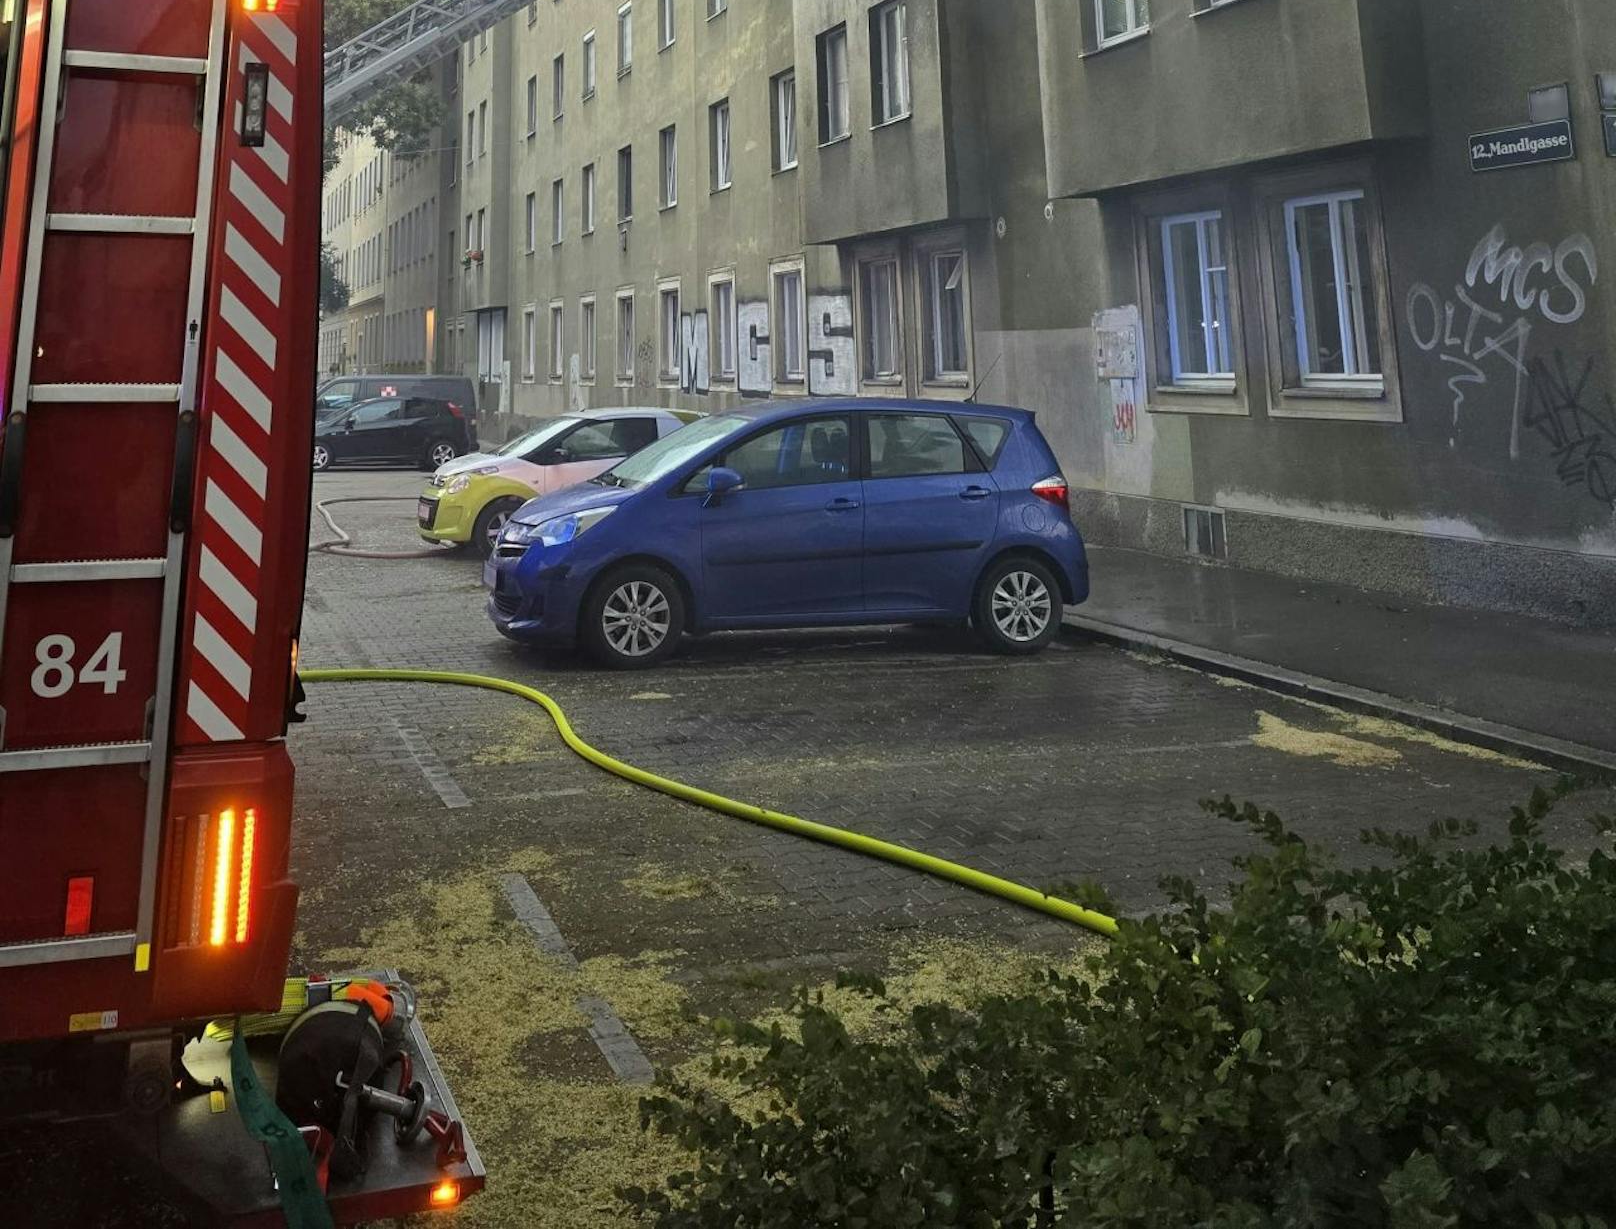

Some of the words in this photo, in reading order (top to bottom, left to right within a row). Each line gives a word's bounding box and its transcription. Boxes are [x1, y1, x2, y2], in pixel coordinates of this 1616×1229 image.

[1489, 134, 1568, 156] Mandlgasse
[1465, 225, 1597, 323] MCS
[30, 631, 127, 699] 84
